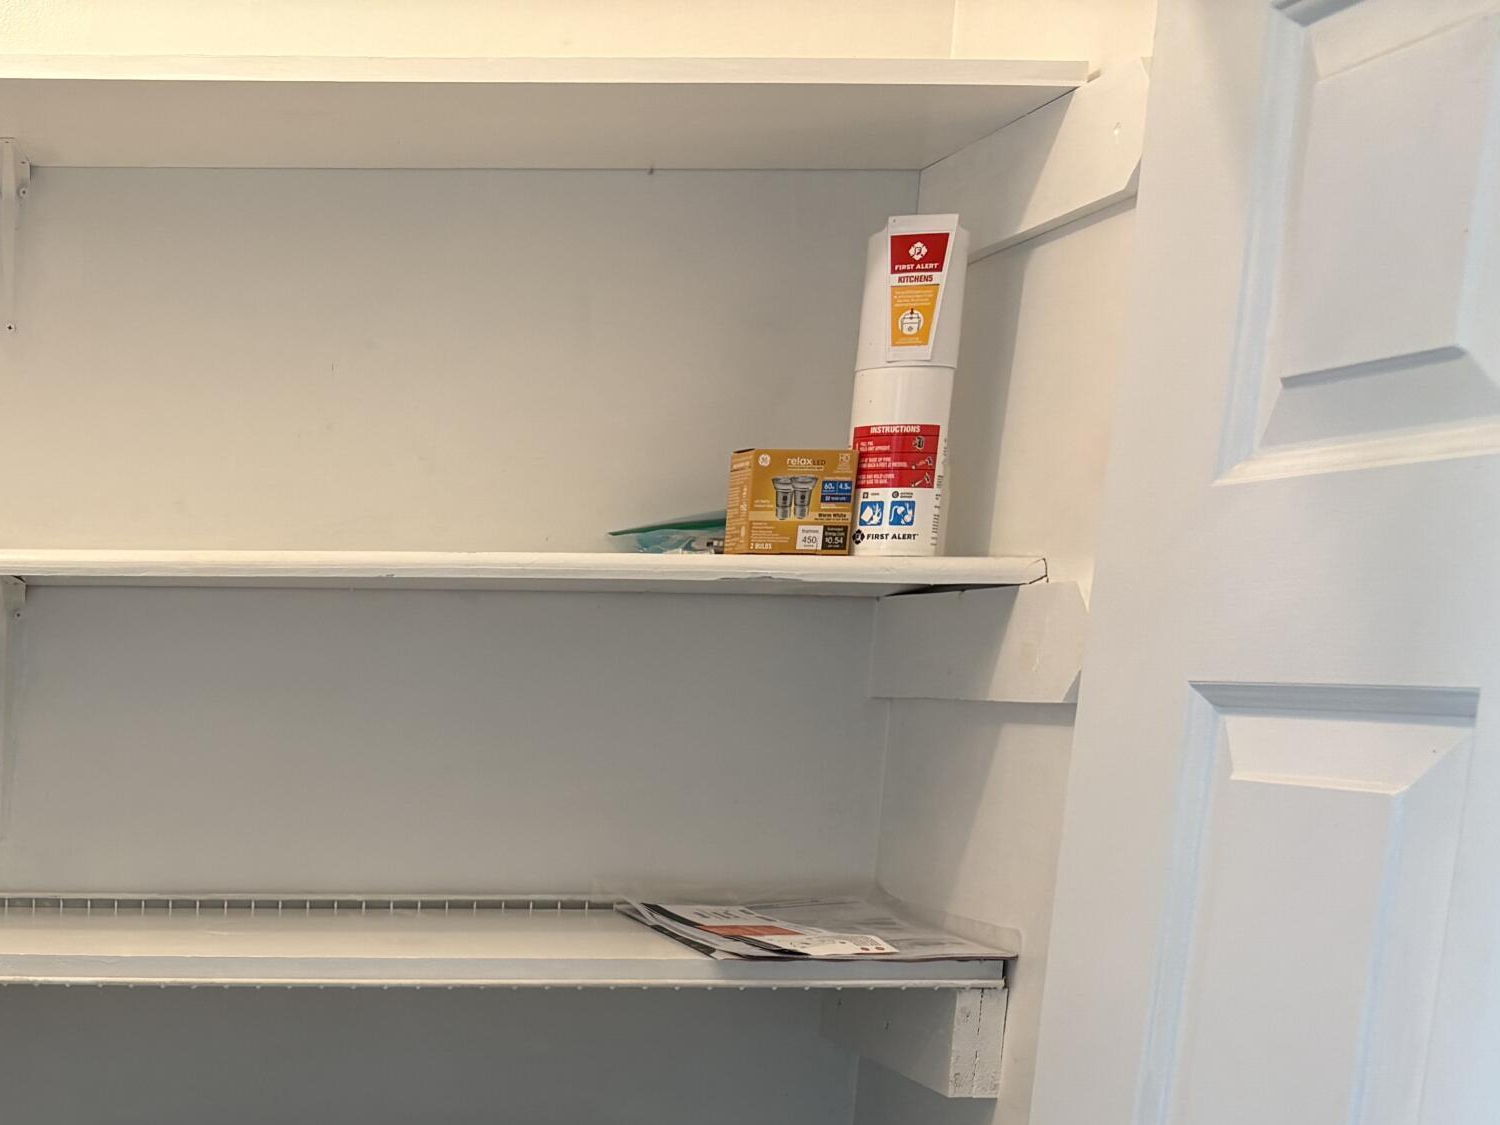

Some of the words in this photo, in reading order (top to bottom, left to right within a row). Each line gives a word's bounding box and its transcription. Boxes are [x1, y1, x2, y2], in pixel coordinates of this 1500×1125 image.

[916, 262, 939, 270] ALERT
[898, 274, 933, 283] KITCHENS
[870, 425, 921, 434] INSTRUCTIONS
[787, 457, 813, 466] relax
[802, 536, 817, 544] 450
